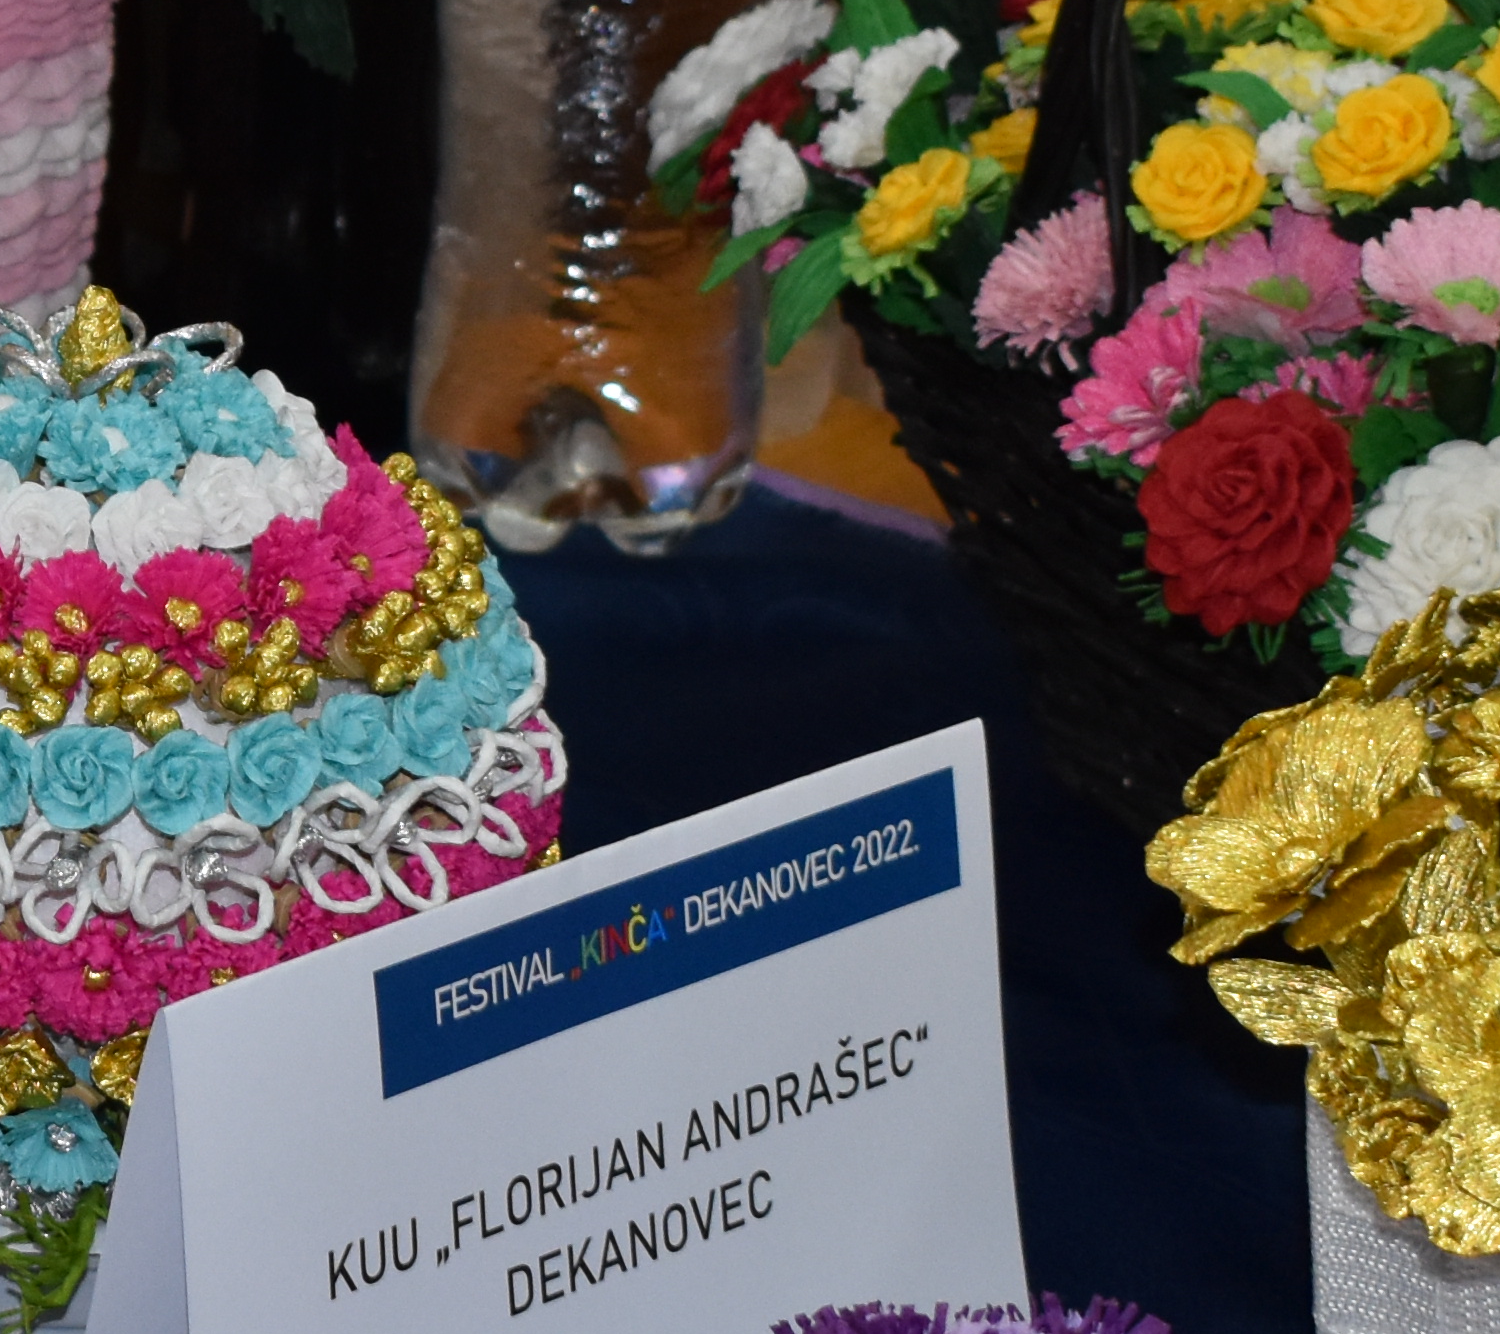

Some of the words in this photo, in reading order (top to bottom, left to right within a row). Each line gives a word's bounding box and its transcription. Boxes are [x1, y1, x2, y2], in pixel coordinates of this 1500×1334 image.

[434, 947, 565, 1026] FESTIVAL
[683, 843, 846, 934] DEKANOVEC
[851, 818, 920, 874] 2022.
[327, 1217, 419, 1301] KUU
[507, 1169, 773, 1317] DEKANOVEC
